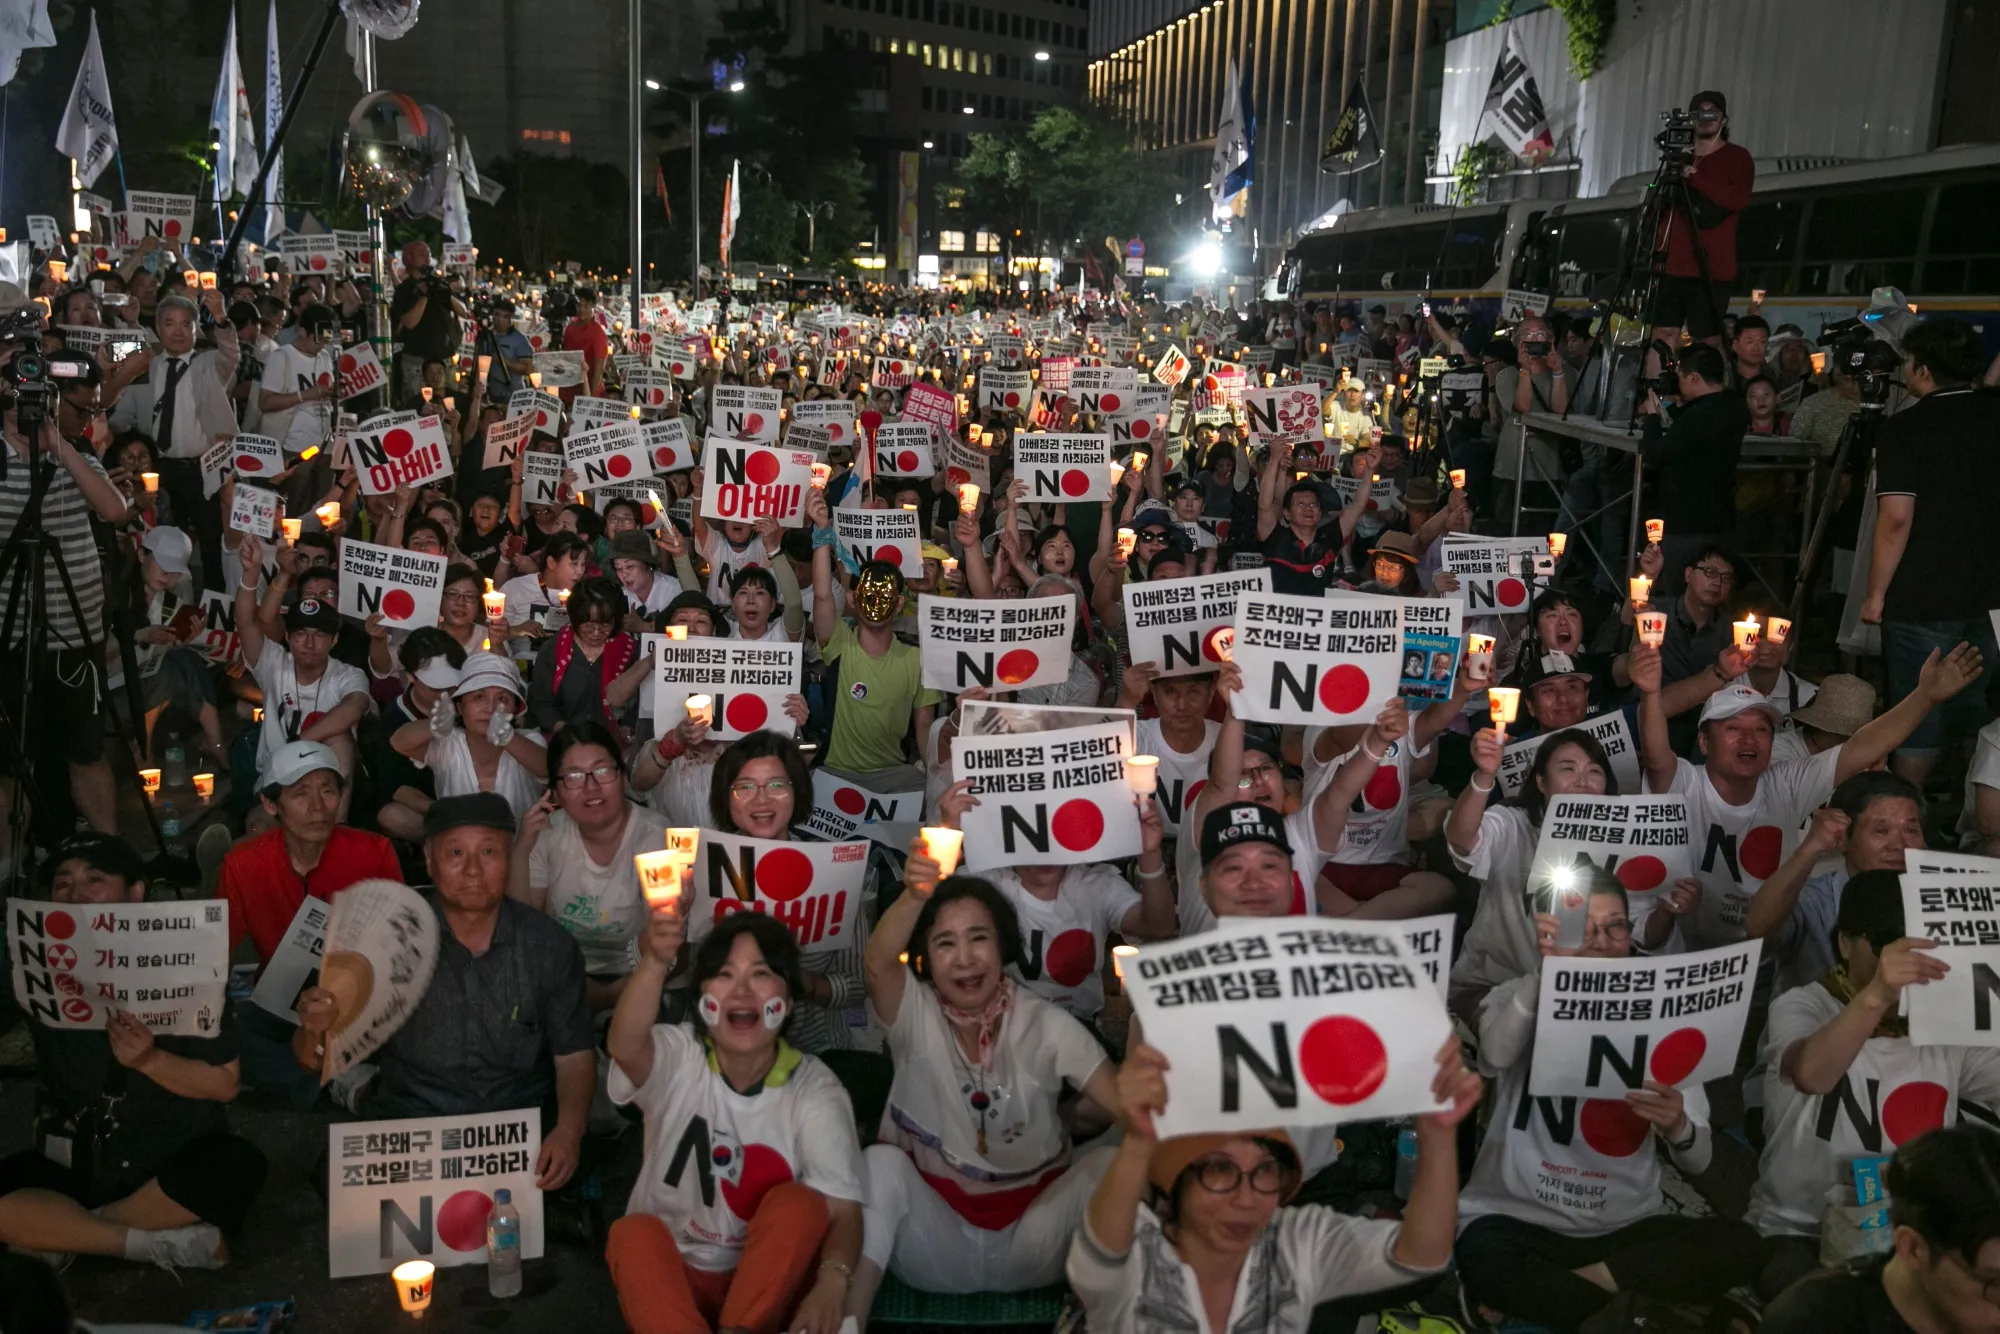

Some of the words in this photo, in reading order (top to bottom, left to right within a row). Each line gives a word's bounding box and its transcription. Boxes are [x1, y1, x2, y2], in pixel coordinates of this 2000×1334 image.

[989, 391, 1020, 408] NO
[1080, 392, 1120, 413] NO
[567, 434, 598, 449] 토착왜구
[1113, 419, 1150, 441] NO
[355, 428, 414, 469] NO
[568, 446, 601, 461] 조선일보
[1019, 438, 1060, 450] 아베정권
[1063, 439, 1104, 451] 규탄한다
[1019, 451, 1060, 464] 강제징용
[1062, 453, 1105, 464] 사죄하라
[584, 454, 632, 484] NO
[716, 448, 780, 486] NO
[878, 450, 919, 472] NO
[1035, 469, 1090, 497] NO
[717, 484, 801, 519] 아베!
[837, 512, 872, 525] 아베정권
[876, 514, 915, 526] 규탄한다
[839, 526, 872, 539] 강제징용
[876, 528, 916, 539] 사죄하라
[345, 545, 388, 564] 토착왜구
[391, 554, 440, 574] 몰아내자
[1448, 549, 1491, 562] 아베정권
[1449, 562, 1493, 575] 강제징용
[344, 560, 386, 579] 조선일보
[388, 569, 438, 589] 폐간하라
[357, 582, 415, 621] NO
[1131, 587, 1196, 608] 아베정권
[1468, 578, 1526, 609] NO
[930, 606, 995, 624] 토착왜구
[1001, 605, 1066, 623] 몰아내자
[1135, 606, 1198, 627] 강제징용
[1246, 603, 1324, 628] 토착왜구
[1330, 609, 1398, 629] 몰아내자
[930, 624, 995, 642] 조선일보
[1000, 624, 1065, 642] 폐간하라
[1244, 627, 1321, 652] 조선일보
[1327, 634, 1397, 653] 폐간하라
[1417, 638, 1449, 649] Apology
[664, 648, 726, 664] 아베정권
[731, 650, 793, 666] 규탄한다
[957, 648, 1039, 688] NO
[664, 668, 725, 684] 강제징용
[730, 670, 792, 685] 사죄하라
[1269, 661, 1370, 714] NO
[964, 746, 1044, 769] 아베정권
[1051, 736, 1121, 764] 규탄한다
[966, 771, 1046, 794] 강제징용
[1053, 761, 1124, 790] 사죄하라
[1001, 797, 1105, 853] NO
[1556, 803, 1630, 822] 아베정권
[1634, 804, 1687, 823] 규탄한다
[1218, 823, 1277, 843] KOREA
[1551, 823, 1625, 844] 강제징용
[1629, 827, 1689, 846] 사죄하라
[1701, 823, 1783, 883] NO
[707, 841, 813, 902] NO
[137, 917, 196, 932] 않습니다!
[95, 949, 129, 969] 가지
[136, 953, 195, 968] 않습니다!
[1138, 933, 1273, 981] 아베정권
[1277, 929, 1400, 958] 규탄한다
[1149, 967, 1282, 1007] 강제징용
[1290, 961, 1416, 999] 사죄하라
[1555, 970, 1656, 993] 아베정권
[1664, 953, 1749, 990] 규탄한다
[136, 986, 194, 1001] 않습니다!
[1553, 998, 1653, 1021] 강제징용
[1660, 982, 1744, 1019] 사죄하라
[1216, 1014, 1389, 1113] NO
[1585, 1027, 1707, 1089] NO
[342, 1129, 433, 1157] 토착왜구
[441, 1121, 528, 1151] 몰아내자
[342, 1158, 433, 1187] 조선일보
[440, 1150, 529, 1180] 폐간하라
[1541, 1160, 1578, 1175] BOYCOTT
[1581, 1170, 1607, 1179] JAPAN
[380, 1189, 495, 1259] NO
